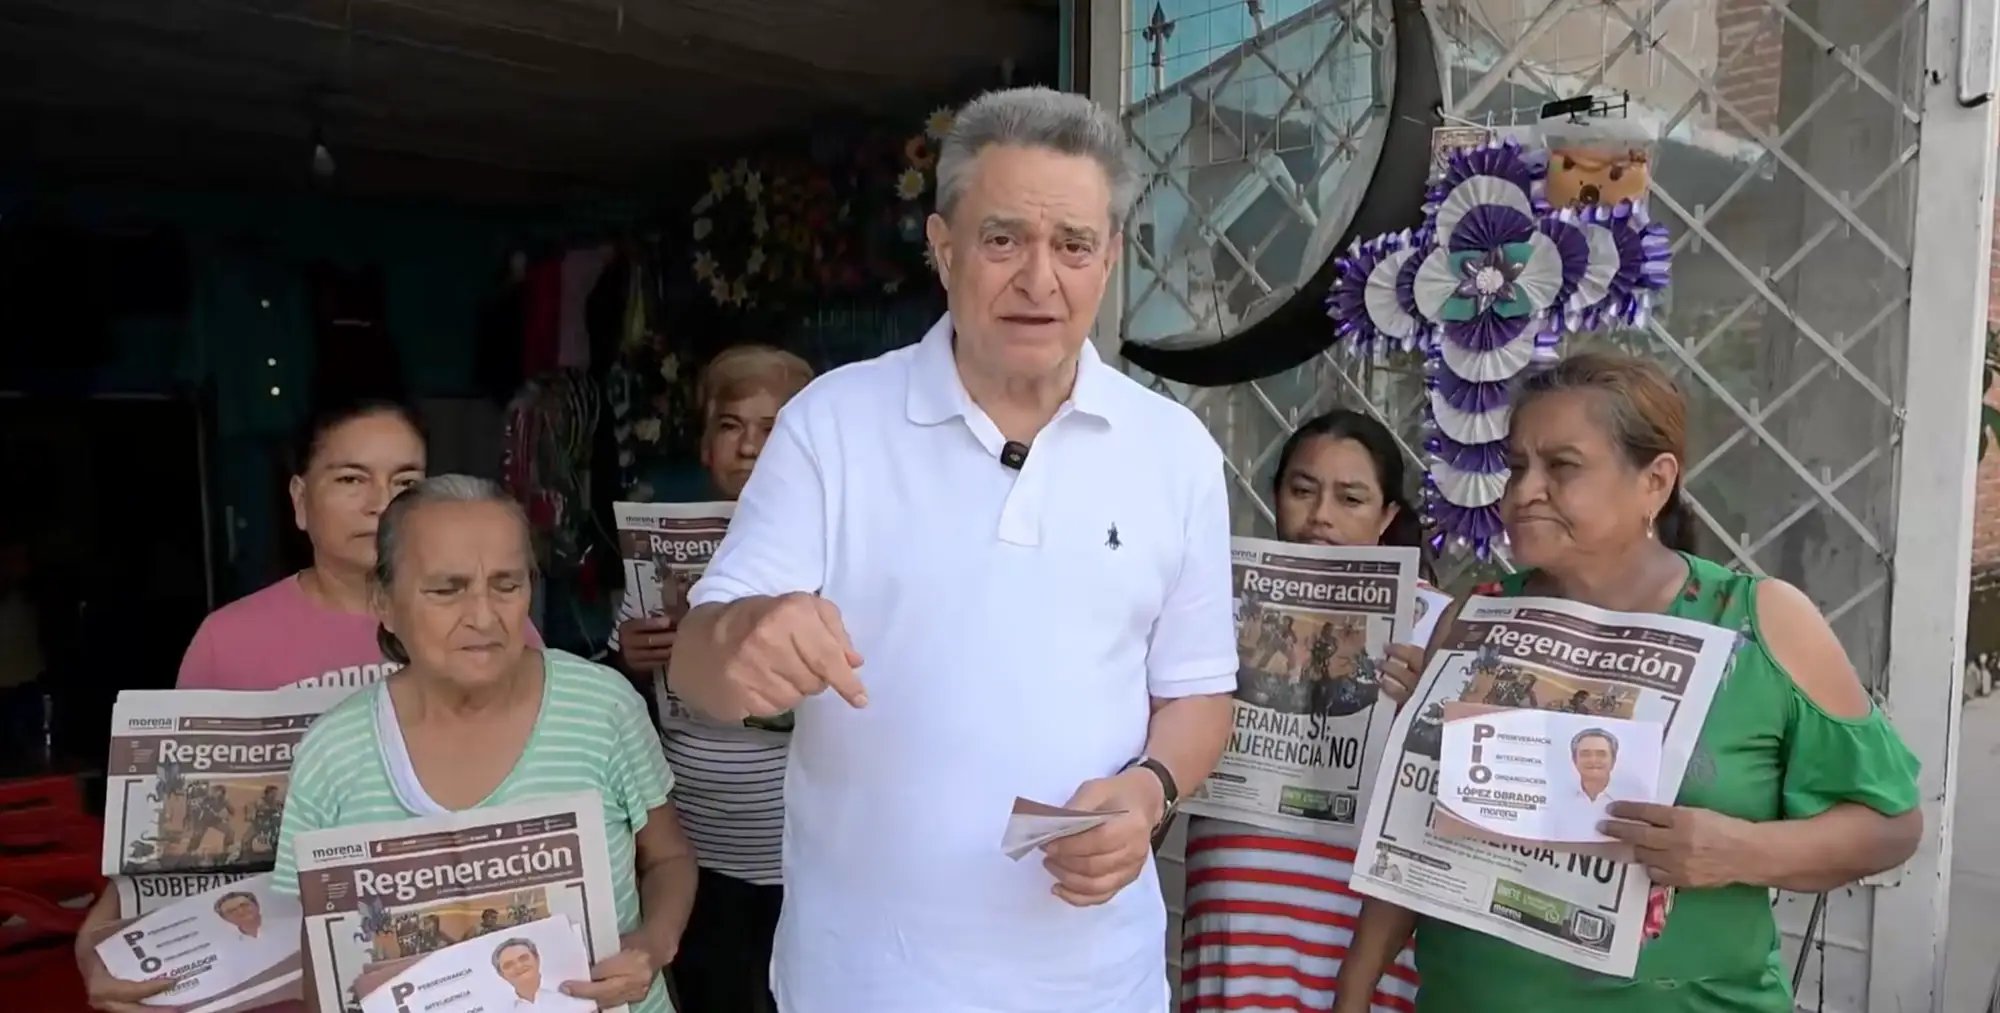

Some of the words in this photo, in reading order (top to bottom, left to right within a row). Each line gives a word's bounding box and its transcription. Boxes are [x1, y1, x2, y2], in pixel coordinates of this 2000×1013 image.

[1243, 569, 1392, 604] Regeneración
[1484, 624, 1683, 683] Regeneración
[1328, 735, 1359, 769] NO
[1493, 789, 1547, 805] OBRADOR
[312, 842, 363, 860] morena
[353, 842, 574, 901] Regeneración
